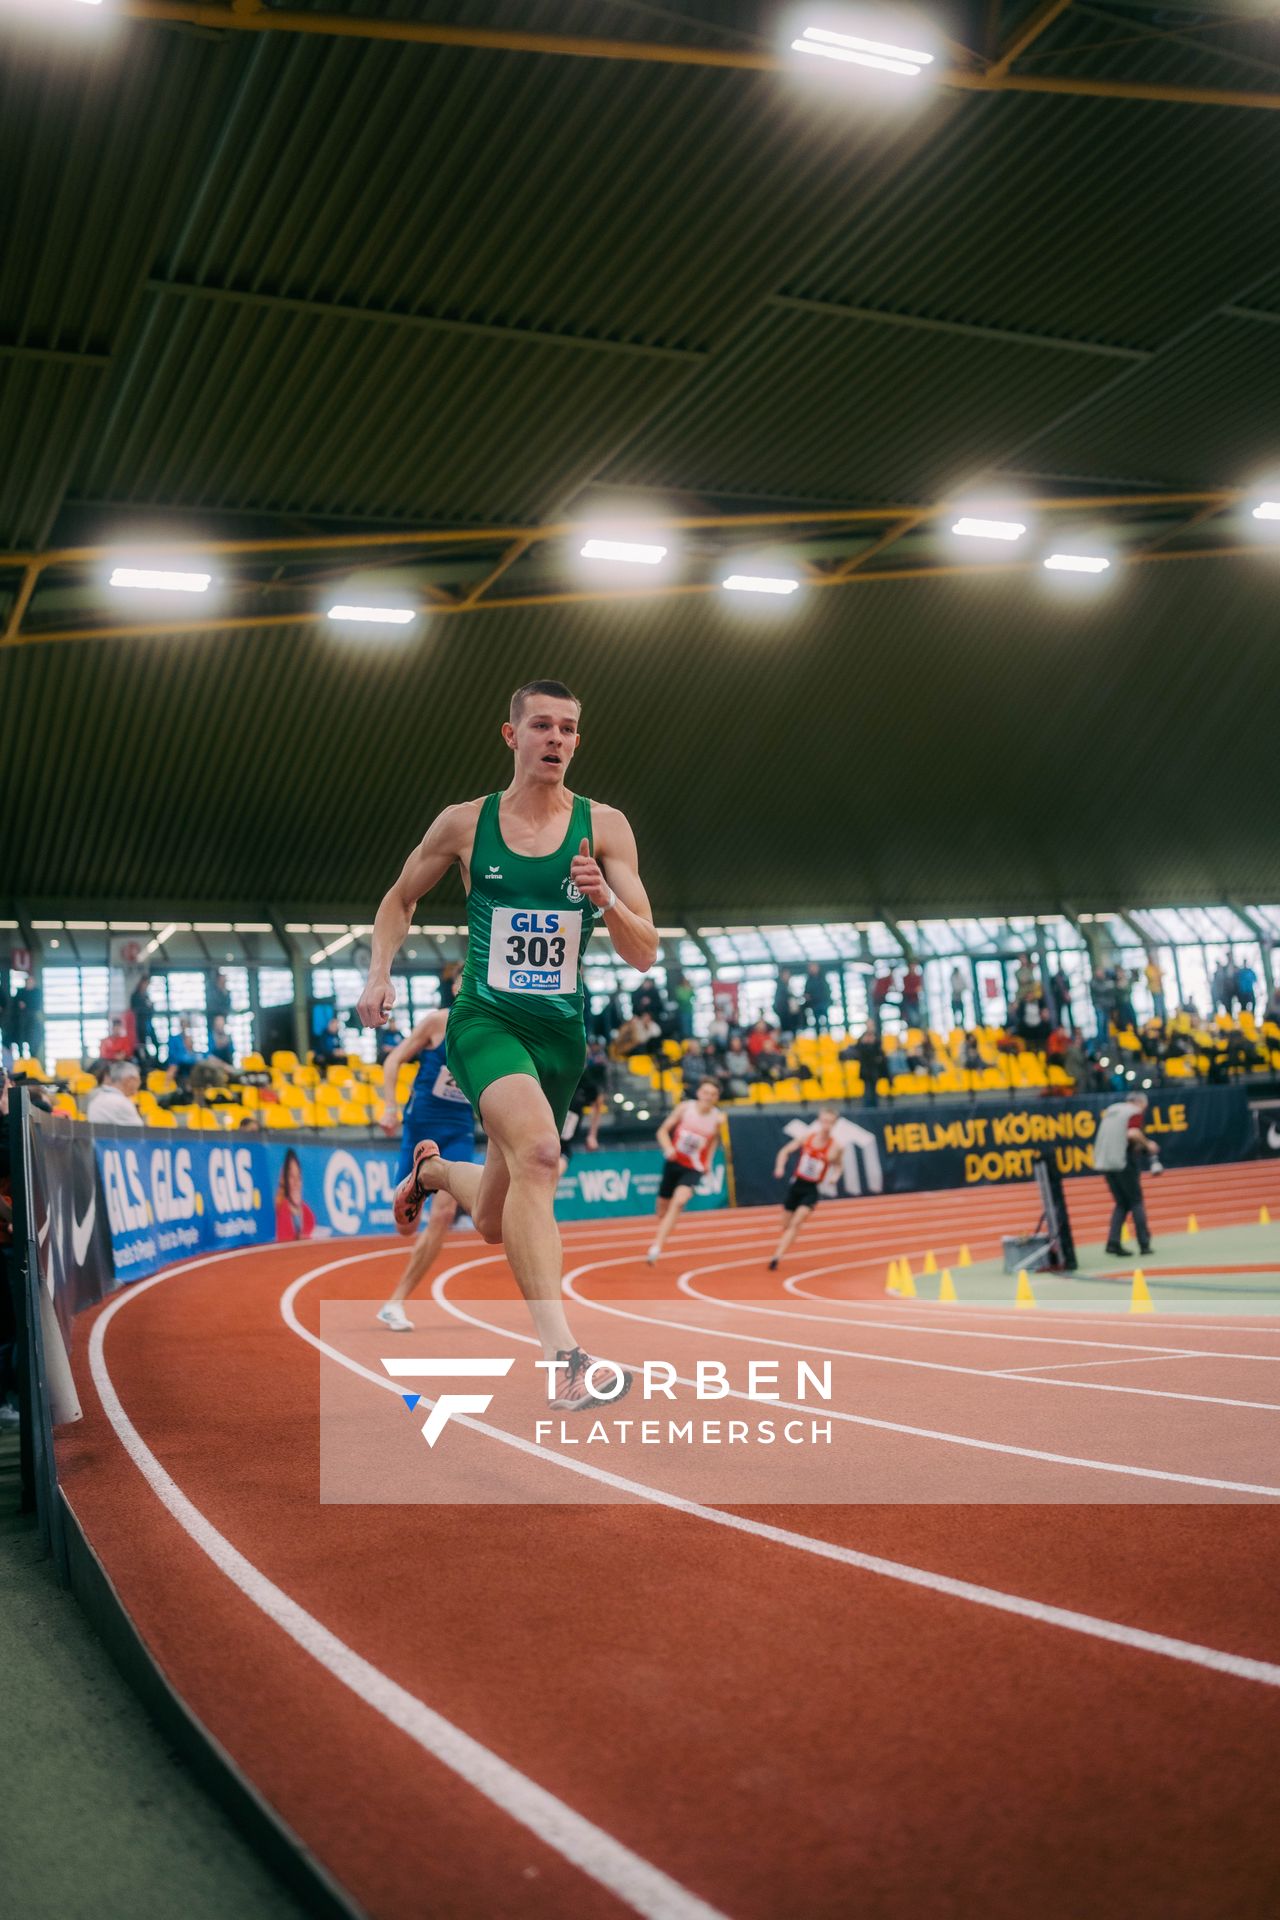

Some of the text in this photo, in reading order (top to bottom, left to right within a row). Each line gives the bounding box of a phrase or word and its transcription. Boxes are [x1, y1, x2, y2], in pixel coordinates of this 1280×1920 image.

[505, 935, 566, 967] 303
[531, 973, 559, 984] PLAN
[884, 1118, 988, 1153] HELMUT
[991, 1110, 1096, 1147] KÖRNIG
